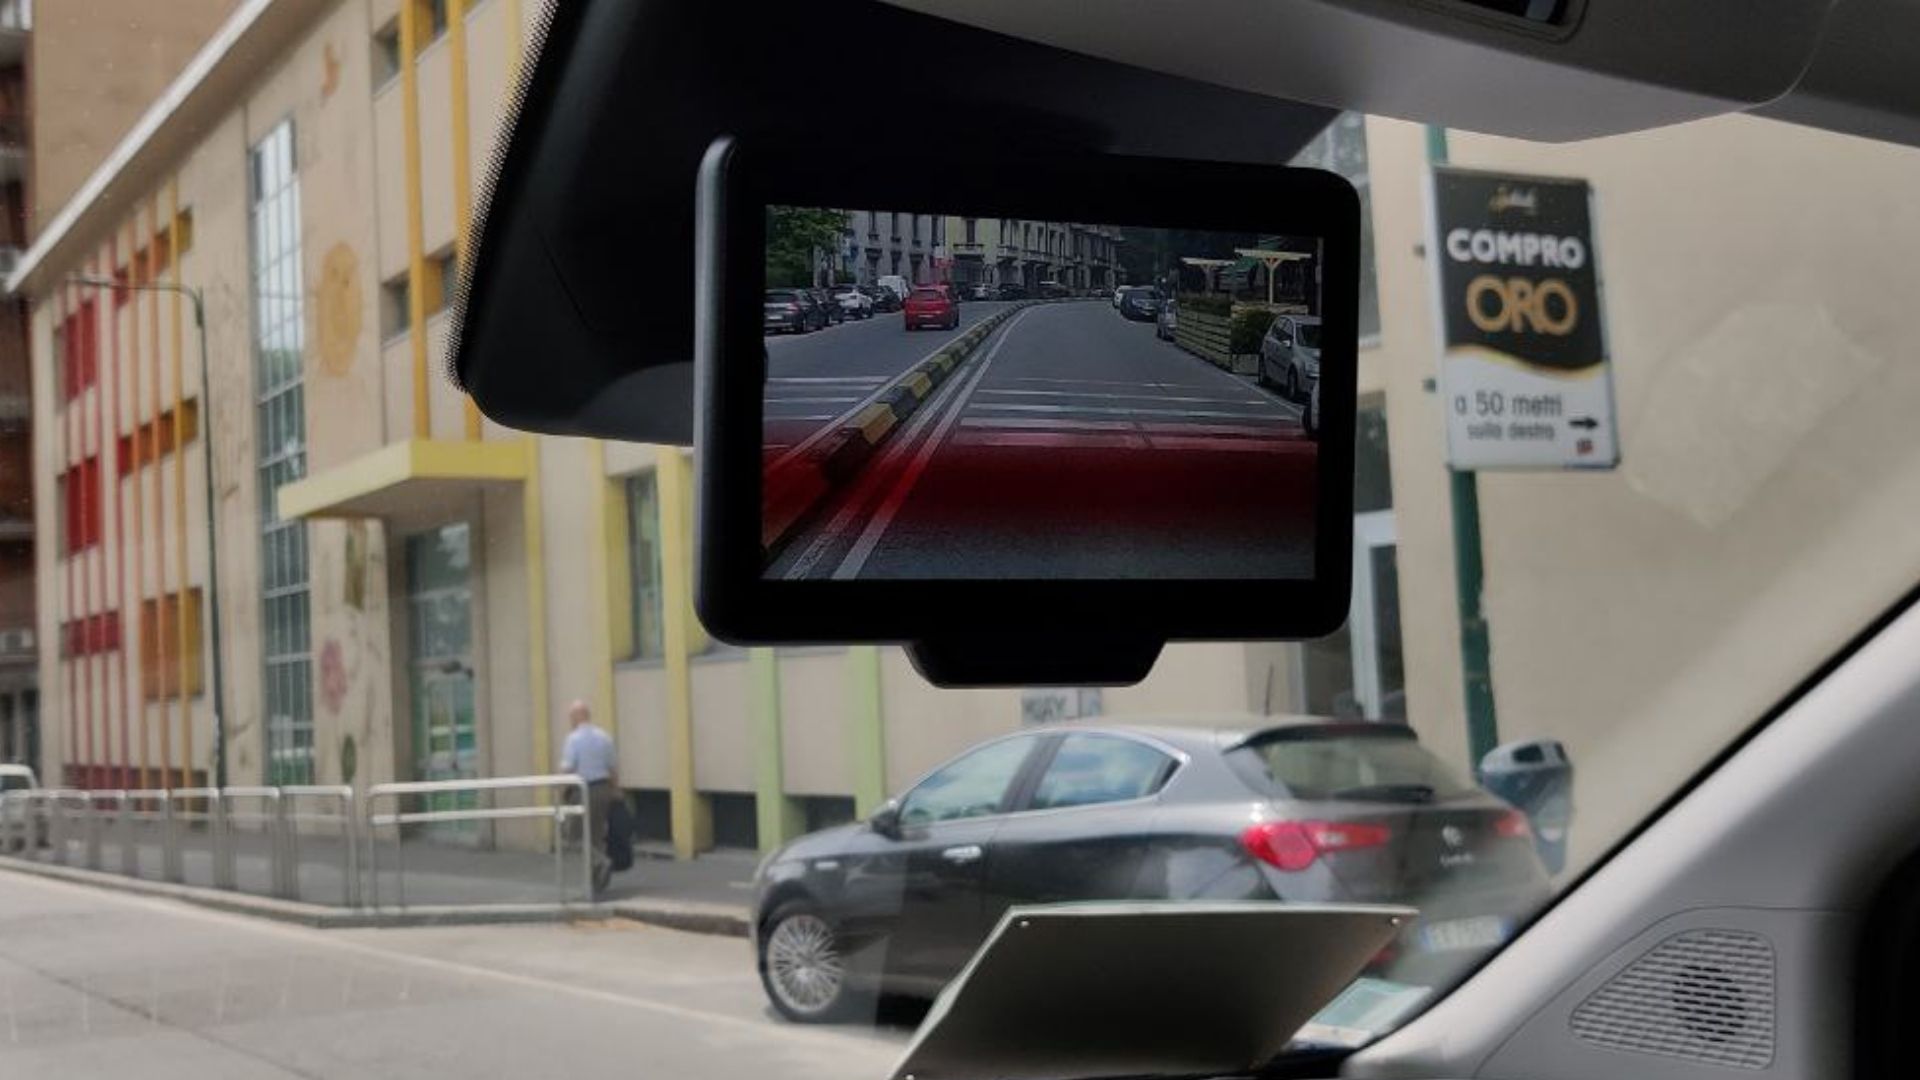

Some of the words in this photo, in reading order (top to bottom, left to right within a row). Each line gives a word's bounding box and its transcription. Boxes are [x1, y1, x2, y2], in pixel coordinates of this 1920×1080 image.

[1447, 229, 1585, 269] COMPRO
[1466, 275, 1578, 336] ORO
[1455, 395, 1468, 416] a
[1476, 390, 1504, 416] 50
[1511, 394, 1563, 417] metri
